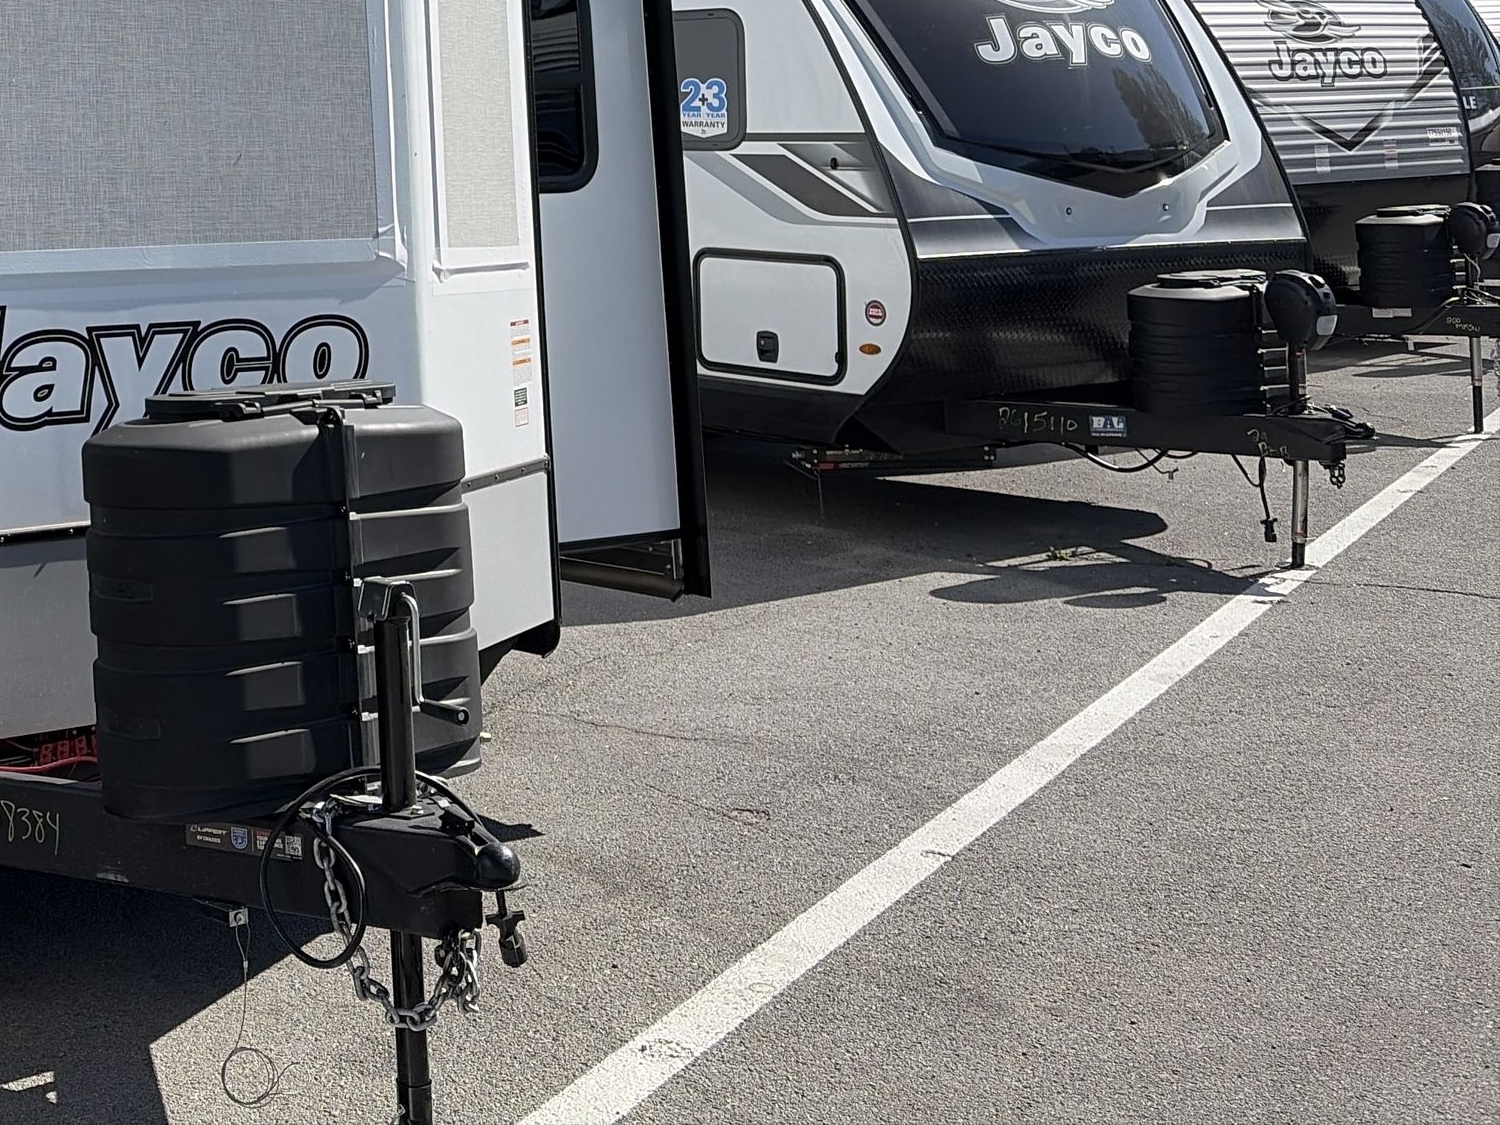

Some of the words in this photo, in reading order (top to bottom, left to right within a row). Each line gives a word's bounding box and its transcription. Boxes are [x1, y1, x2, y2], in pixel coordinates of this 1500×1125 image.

[974, 14, 1153, 67] Jayco
[1268, 40, 1388, 87] Jayco
[681, 121, 726, 129] WARRANTY
